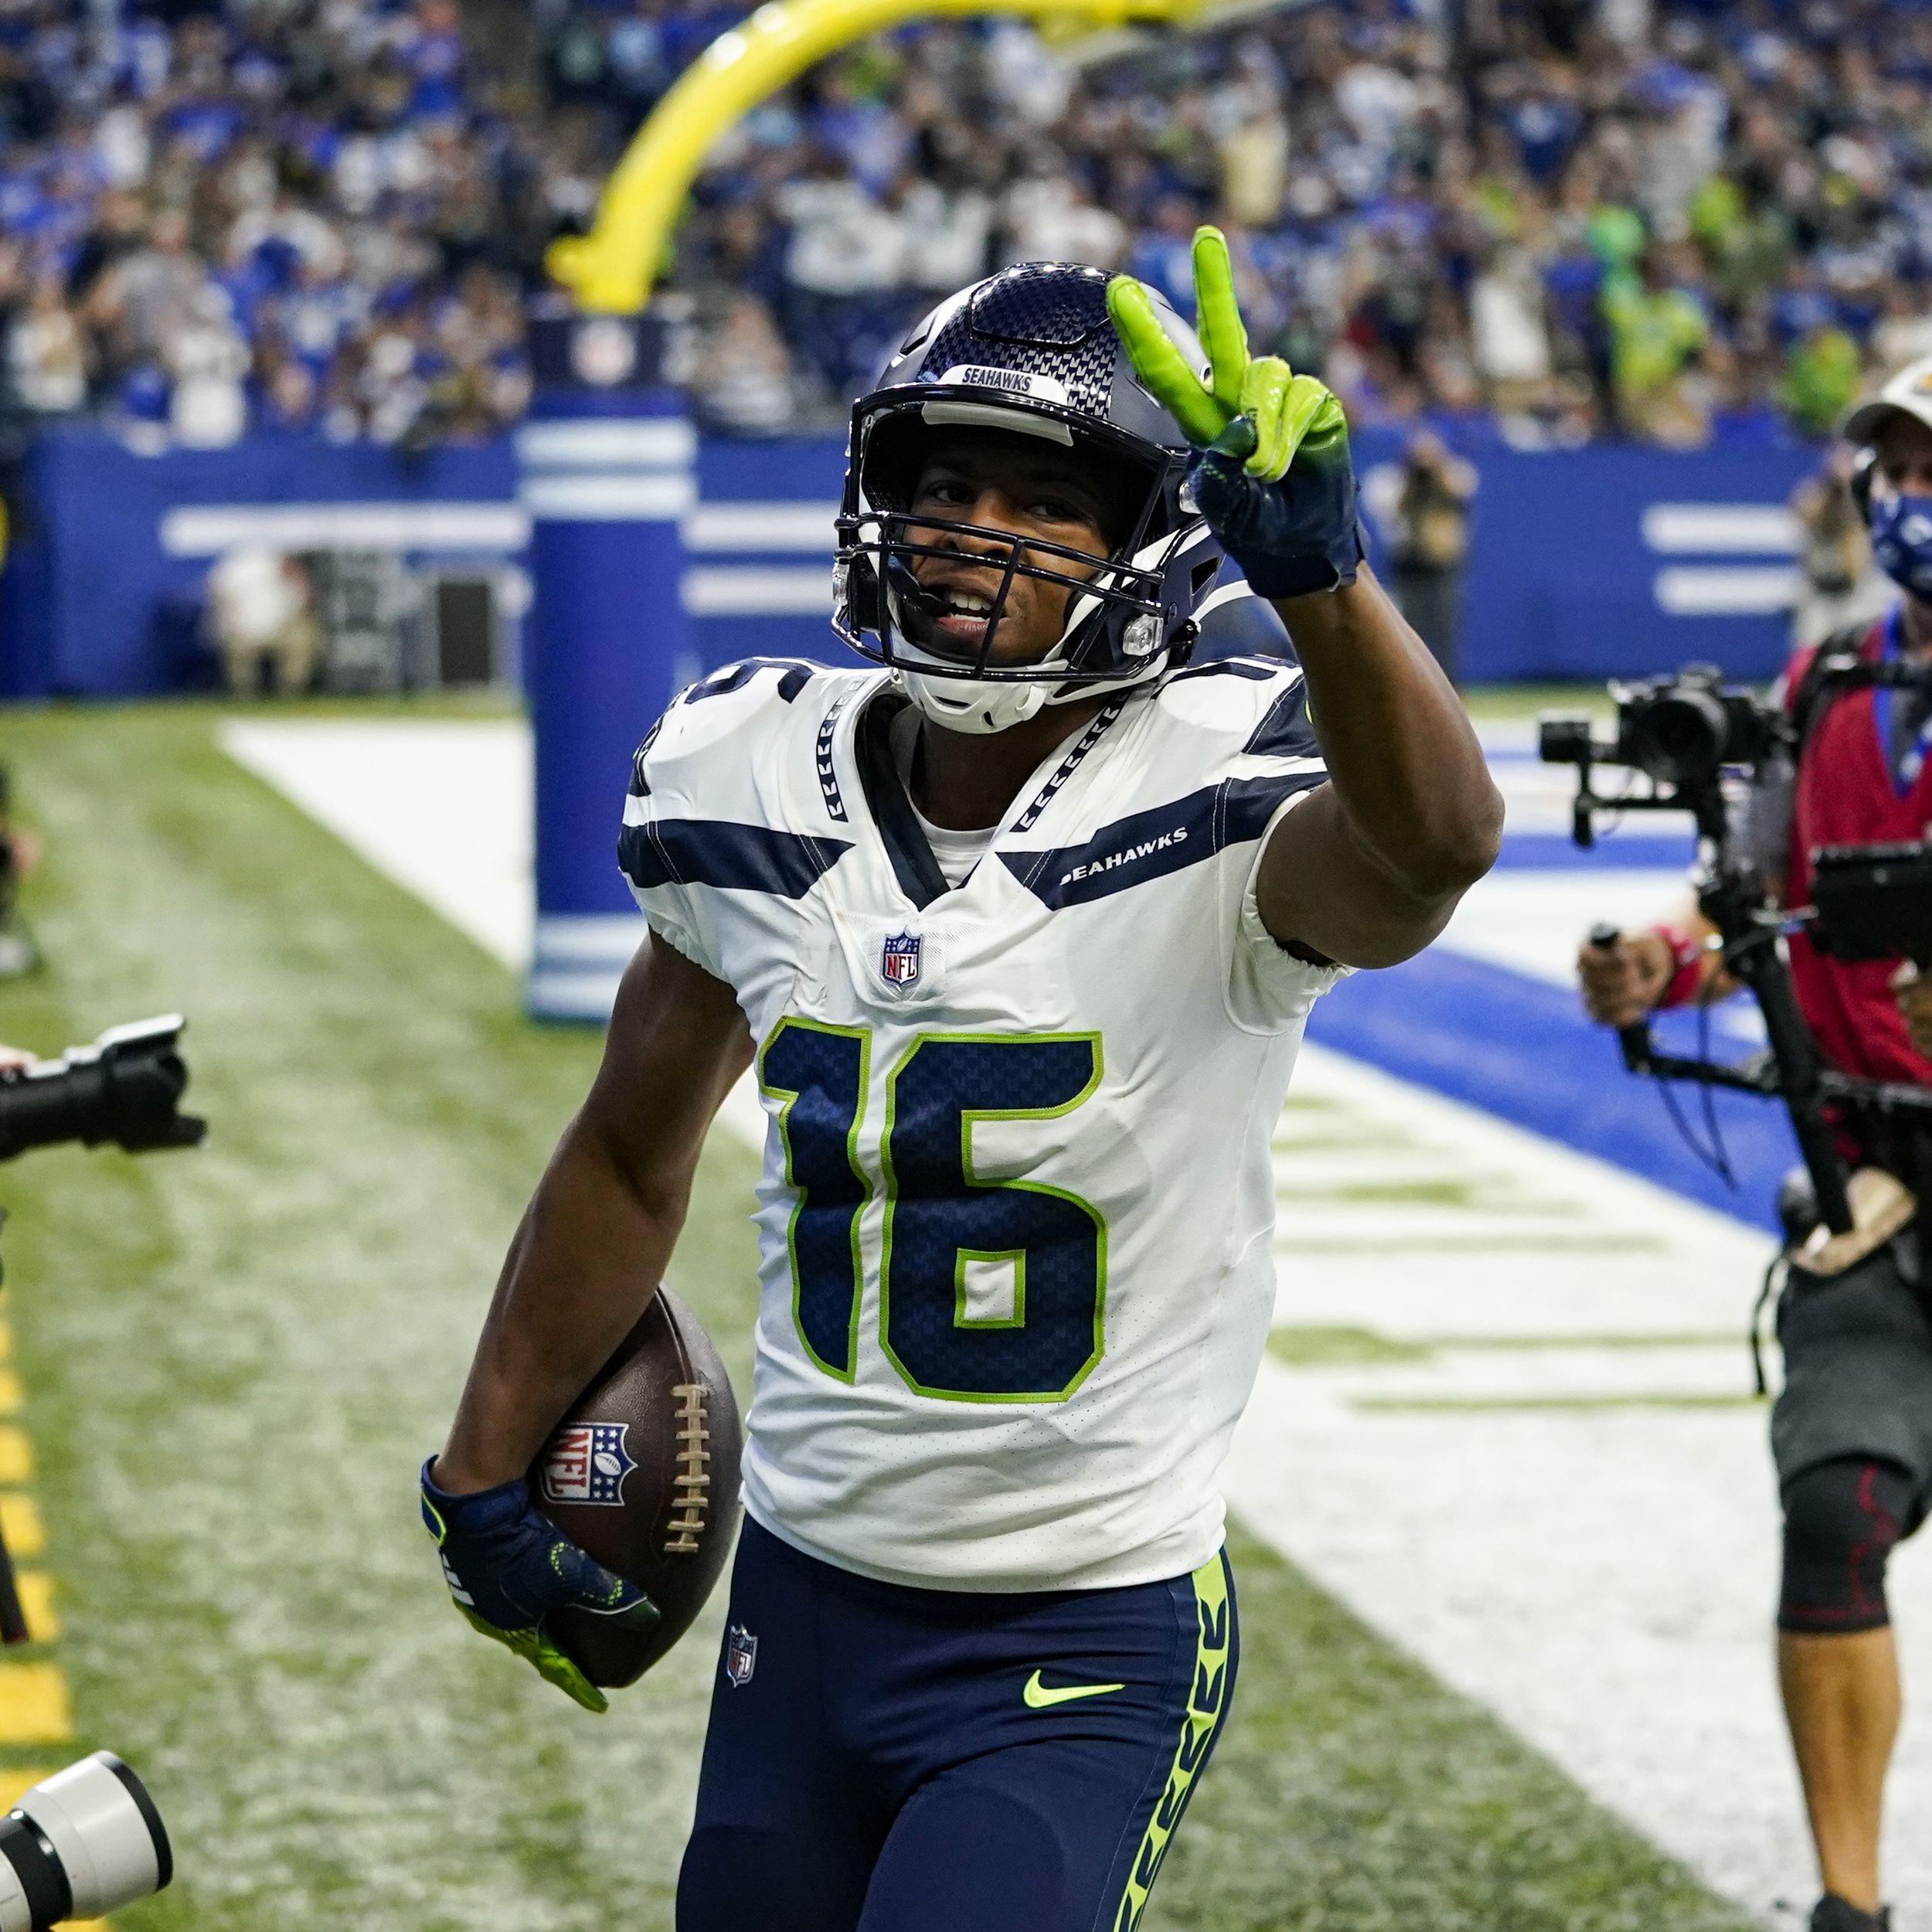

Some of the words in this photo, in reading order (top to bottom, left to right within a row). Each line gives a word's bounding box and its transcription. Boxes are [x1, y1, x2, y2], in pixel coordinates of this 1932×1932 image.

[961, 367, 1032, 393] SEAHAWKS
[886, 954, 916, 980] NFL
[757, 1015, 1108, 1403] 16
[545, 1431, 590, 1495] NFL
